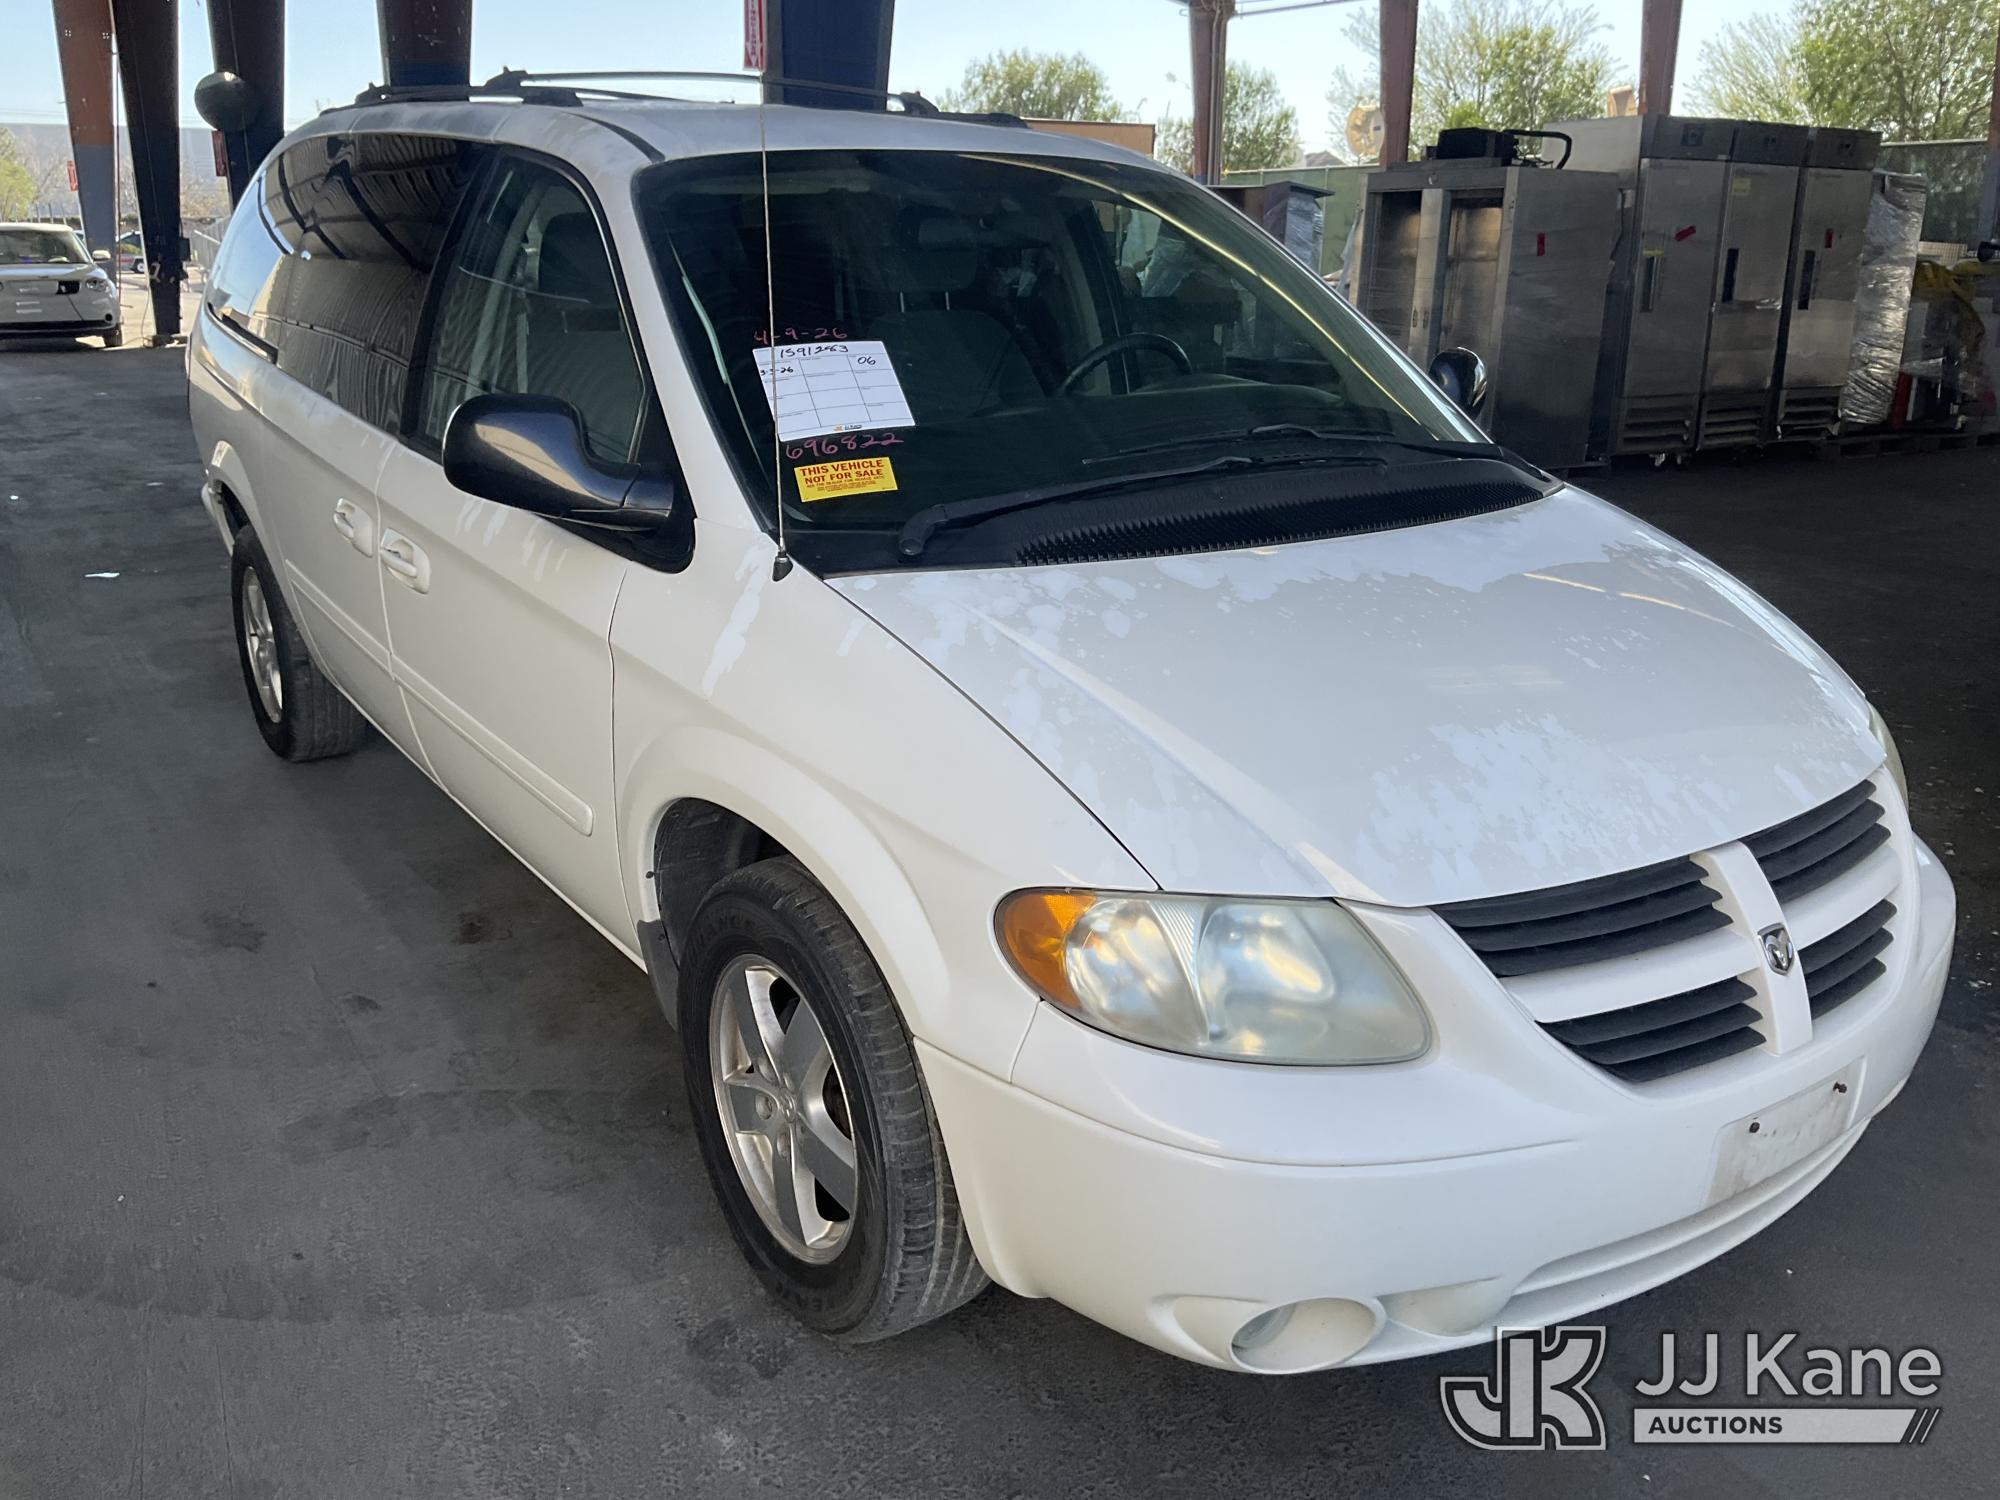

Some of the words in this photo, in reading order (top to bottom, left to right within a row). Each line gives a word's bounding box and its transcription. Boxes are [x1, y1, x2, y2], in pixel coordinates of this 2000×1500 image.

[857, 356, 876, 366] 06
[785, 432, 904, 459] 696822
[800, 465, 829, 477] THIS
[831, 459, 885, 472] VEHICLE
[805, 475, 826, 485] NOT
[829, 472, 852, 481] FOR
[855, 468, 883, 478] SALE
